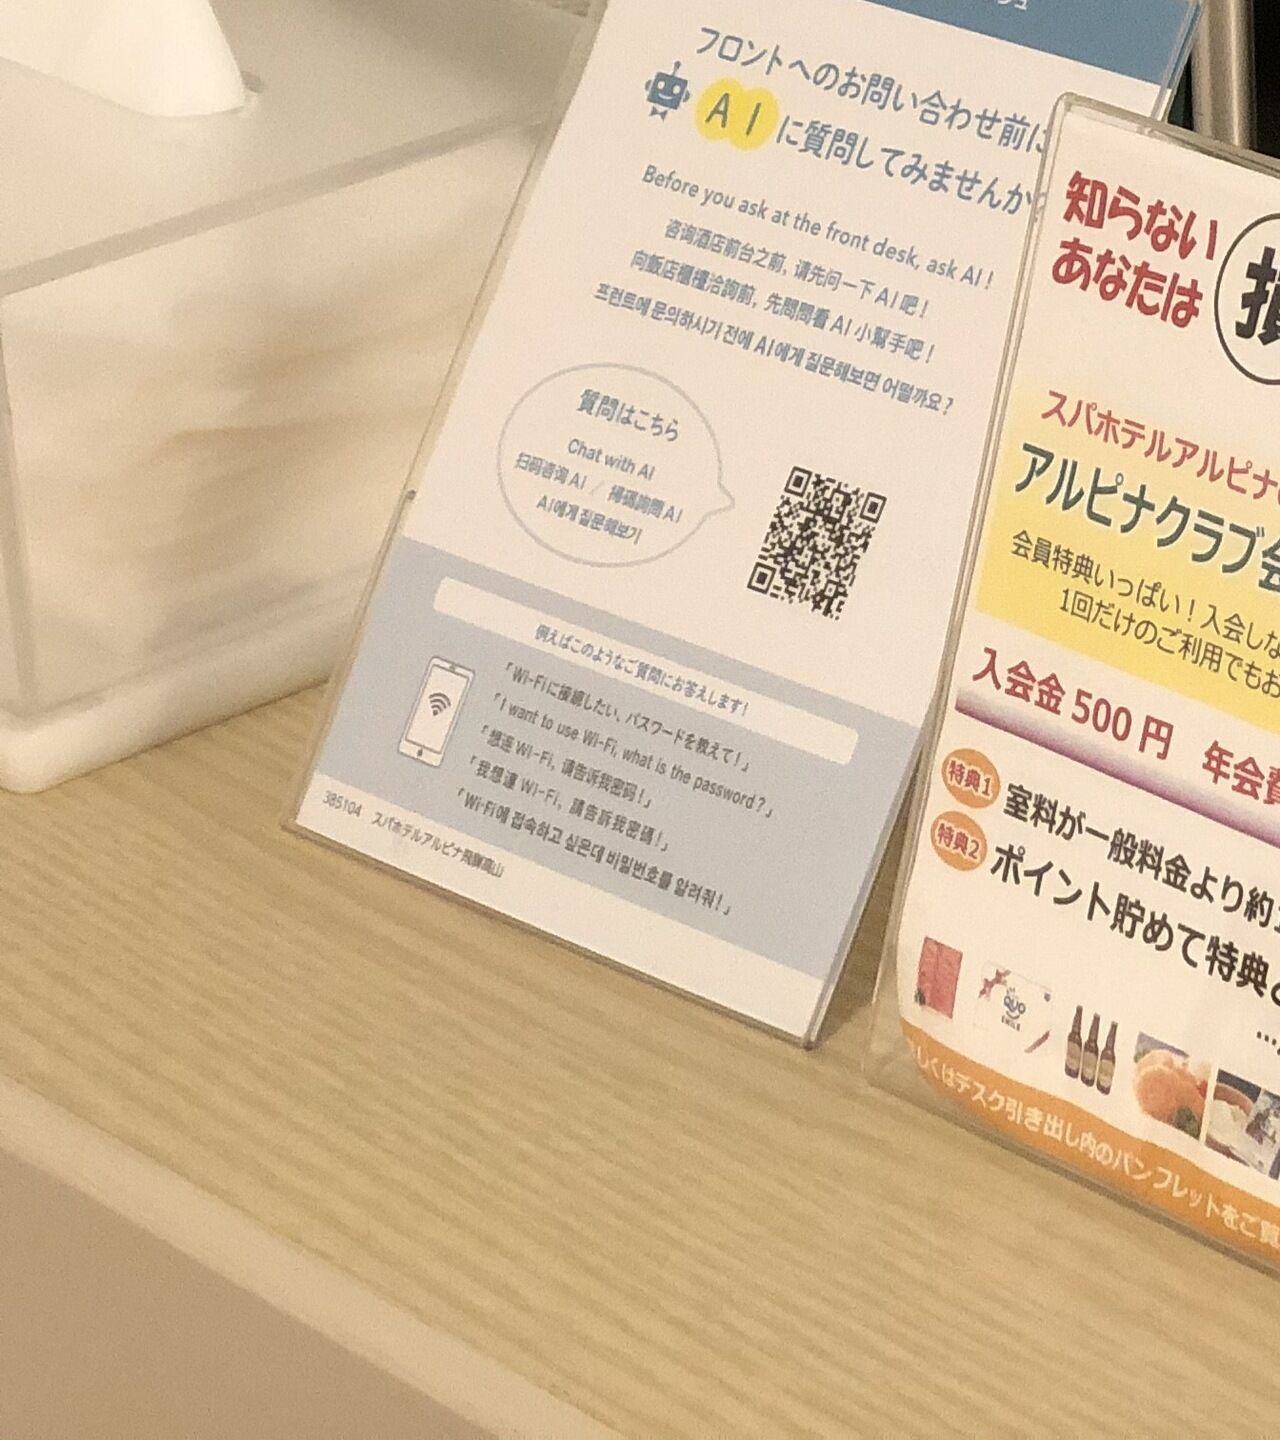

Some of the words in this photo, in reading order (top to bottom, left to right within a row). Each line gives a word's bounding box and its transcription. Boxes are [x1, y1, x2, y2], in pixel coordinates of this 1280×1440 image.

[643, 164, 699, 197] Before
[703, 186, 733, 210] you
[738, 190, 766, 219] ask
[771, 207, 793, 227] at
[794, 209, 821, 236] the
[824, 218, 869, 252] front
[873, 235, 920, 271] desk,
[925, 252, 958, 279] ask
[1063, 170, 1219, 260] 知らない
[1051, 237, 1203, 329] あなたは
[593, 281, 652, 317] 프런트에
[651, 296, 723, 340] 문의하시기
[722, 323, 754, 352] 전에
[754, 335, 803, 369] AI에게
[804, 350, 881, 393] 질문해보면
[576, 388, 680, 443] 質問はこちら
[567, 438, 602, 465] Chat
[603, 452, 636, 475] with
[637, 463, 656, 481] AI
[535, 494, 579, 522] AI에게
[579, 508, 643, 546] 질문해보기
[570, 472, 587, 491] AI
[663, 505, 684, 523] AI
[508, 703, 539, 726] want
[540, 712, 554, 731] to
[556, 721, 580, 741] use
[582, 728, 619, 758] Wi-Fi,
[622, 743, 654, 771] what
[655, 756, 667, 775] is
[670, 764, 692, 785] the
[948, 760, 992, 796] 特典1
[510, 810, 562, 845] 접속하고
[564, 833, 605, 863] 싶은데
[607, 851, 672, 892] 비밀번호를
[937, 822, 980, 859] 特典2
